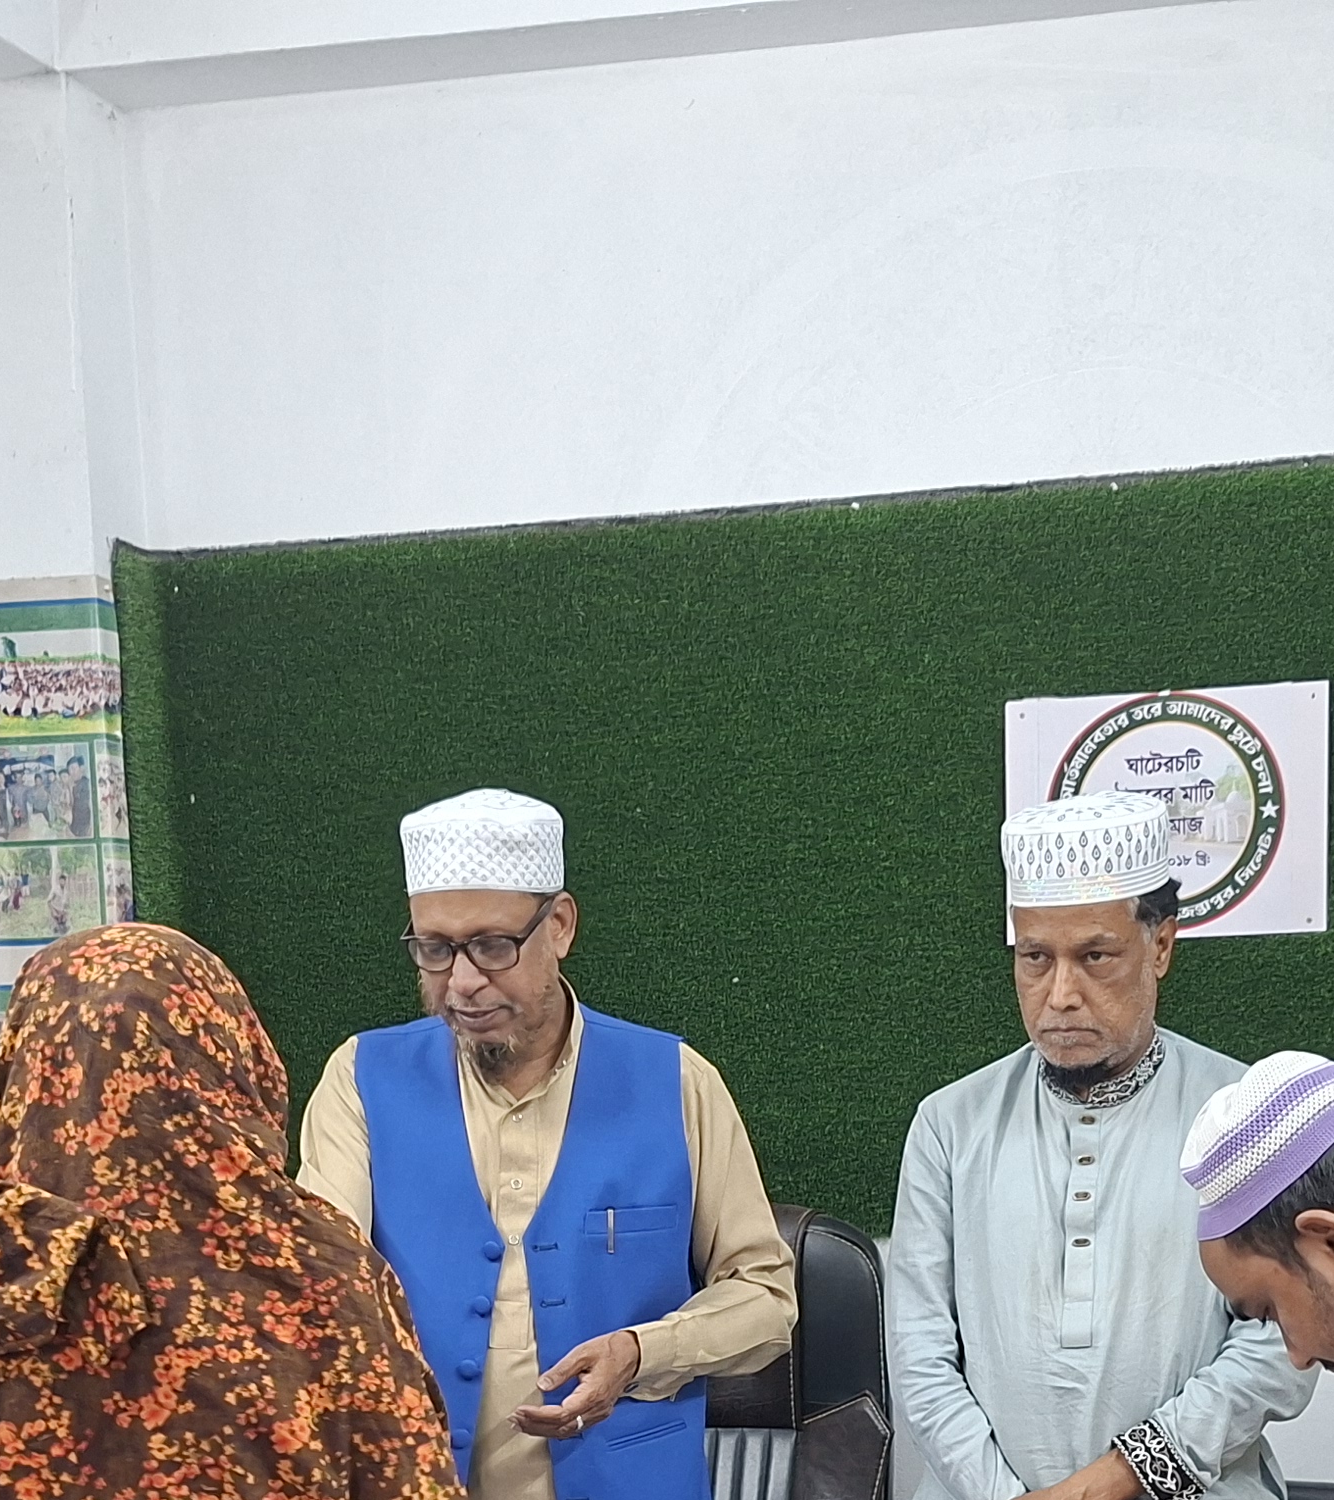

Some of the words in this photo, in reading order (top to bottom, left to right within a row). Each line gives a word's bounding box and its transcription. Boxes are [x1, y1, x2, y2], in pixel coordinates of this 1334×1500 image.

[1130, 701, 1163, 721] তরে
[1165, 701, 1235, 731] আমাদের
[1227, 723, 1262, 755] ছুটে
[1251, 753, 1274, 794] চলা
[1124, 748, 1204, 776] ঘাটেরচটি
[1178, 778, 1216, 804] মাটি
[1168, 854, 1192, 867] ০১৮
